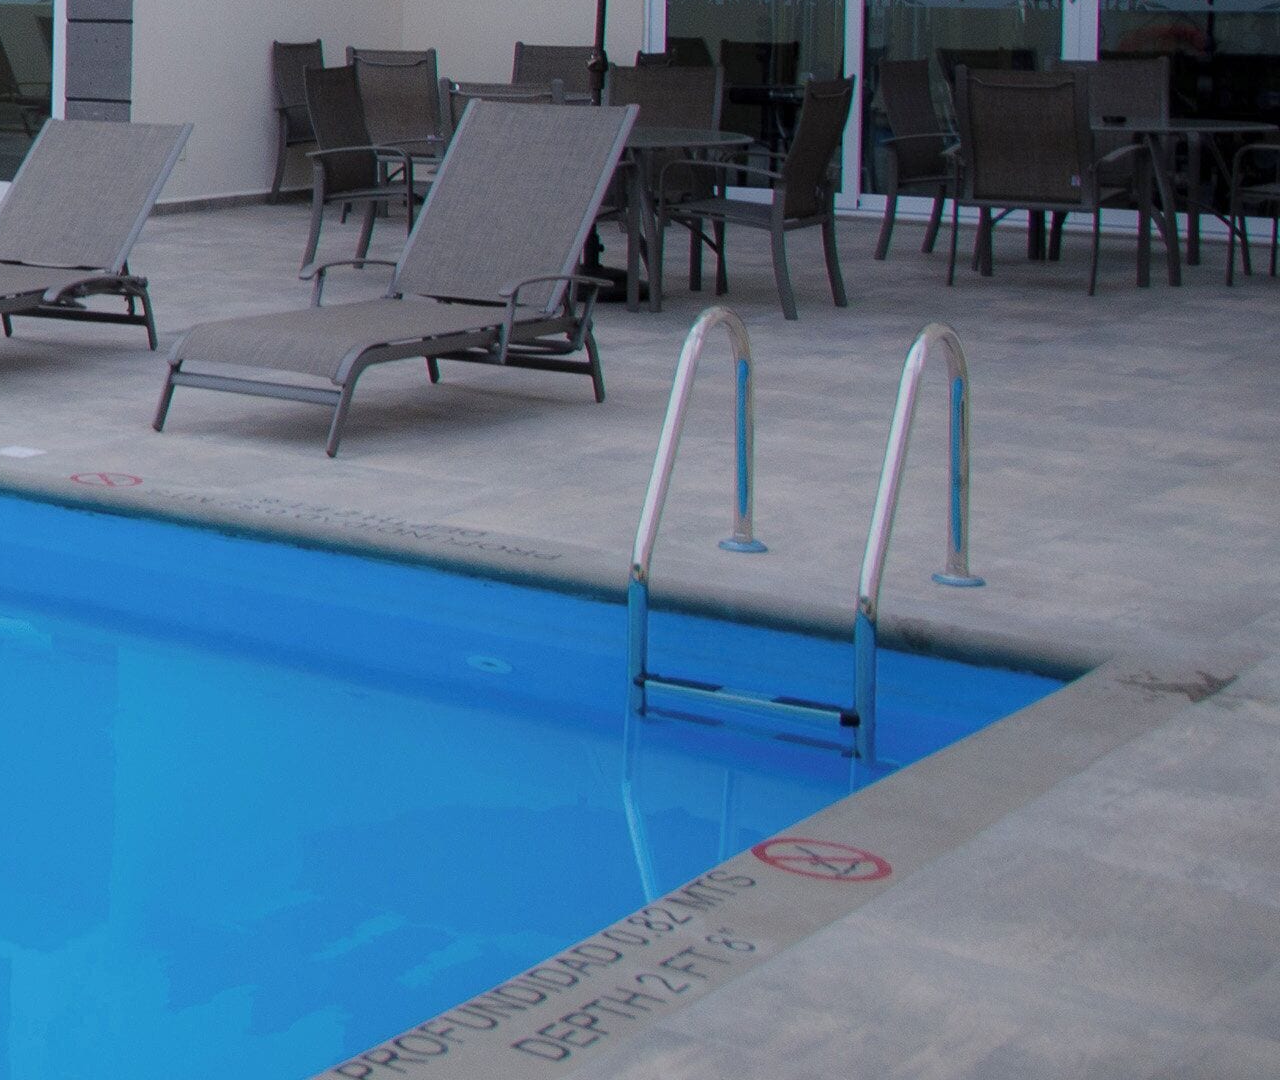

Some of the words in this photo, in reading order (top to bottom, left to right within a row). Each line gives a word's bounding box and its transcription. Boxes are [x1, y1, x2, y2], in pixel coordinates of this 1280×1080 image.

[336, 943, 623, 1080] PROFUNDIDAD
[601, 906, 694, 946] 0.82
[663, 870, 757, 911] MTS
[634, 972, 691, 995] 2
[658, 946, 732, 980] FT
[510, 981, 669, 1062] DEPTH
